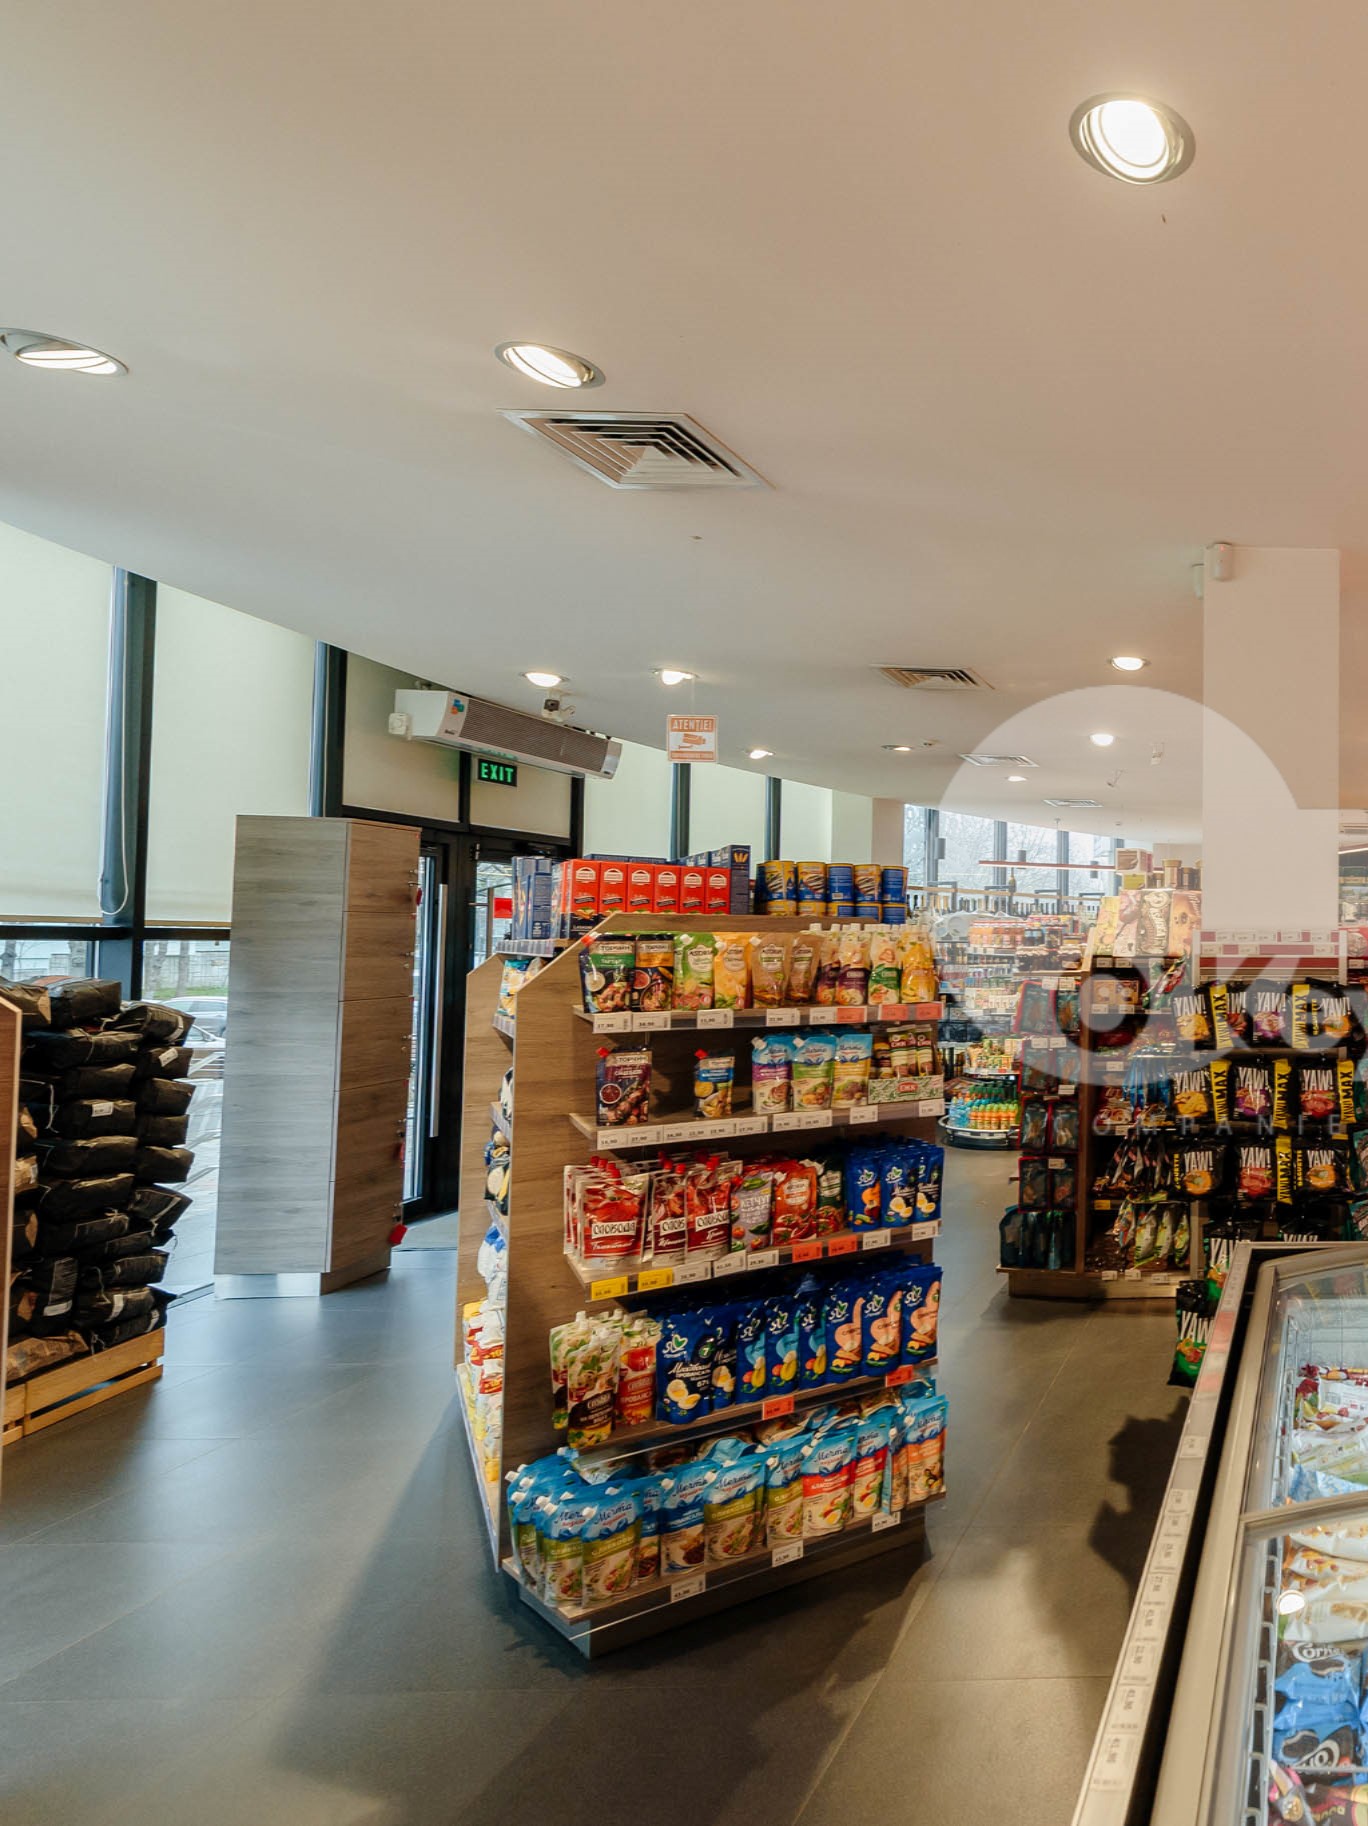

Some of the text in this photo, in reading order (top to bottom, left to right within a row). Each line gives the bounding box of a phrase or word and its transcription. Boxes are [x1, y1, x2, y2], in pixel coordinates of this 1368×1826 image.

[480, 762, 514, 783] EXIT
[1174, 994, 1208, 1018] YAW!
[1212, 994, 1228, 1021] MAX
[1257, 992, 1287, 1012] YAW!
[1293, 994, 1308, 1022] MAX
[1321, 996, 1352, 1017] YAW!
[1174, 1071, 1208, 1093] YAW!
[1213, 1070, 1228, 1096] MAX
[1239, 1067, 1270, 1089] YAW!
[1276, 1073, 1289, 1100] MAX
[1303, 1069, 1335, 1091] YAW!
[1339, 1070, 1353, 1099] MAX
[1184, 1150, 1214, 1172] YAW!
[1240, 1147, 1272, 1169] YAW!
[1277, 1152, 1292, 1176] MAX
[1307, 1149, 1336, 1167] YAW!
